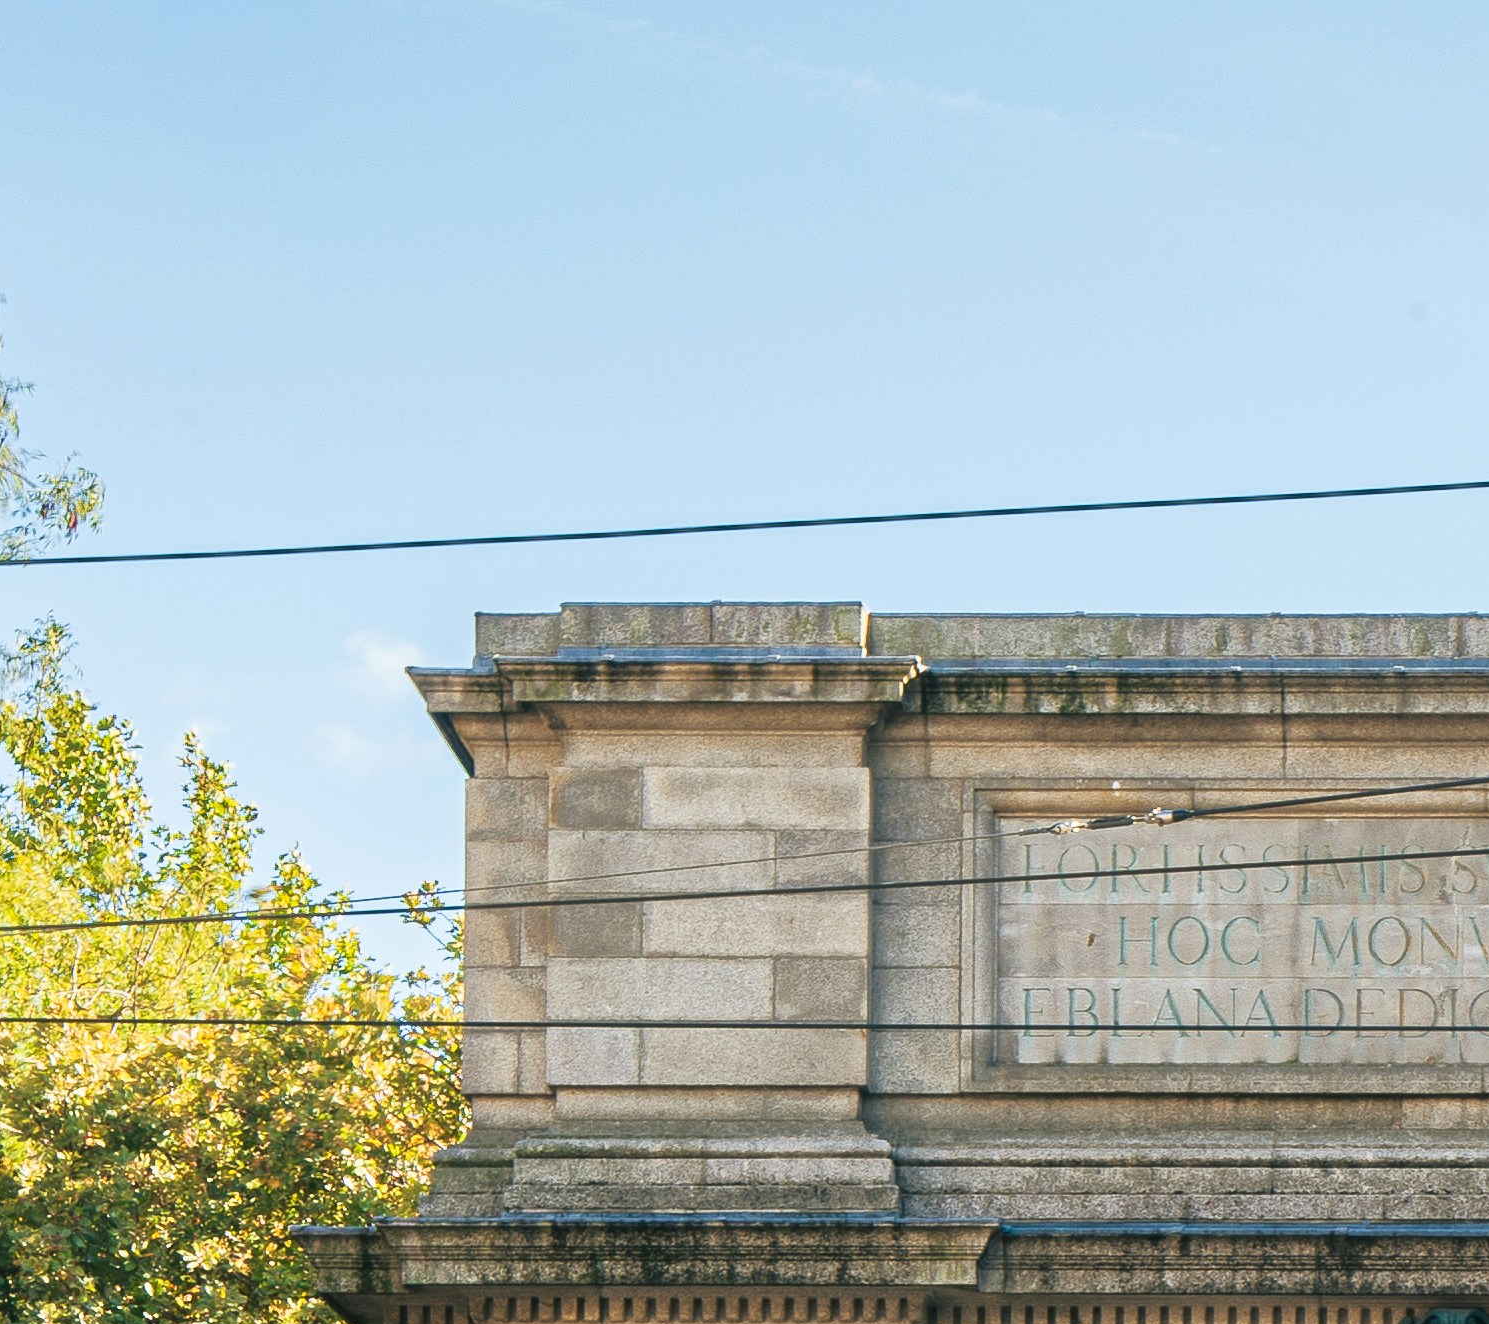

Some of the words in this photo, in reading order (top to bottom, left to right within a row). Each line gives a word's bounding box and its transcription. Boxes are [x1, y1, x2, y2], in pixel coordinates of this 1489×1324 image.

[1021, 843, 1427, 895] FORTISSIMIS
[1116, 915, 1261, 967] HOC
[1021, 987, 1283, 1039] EBLANA
